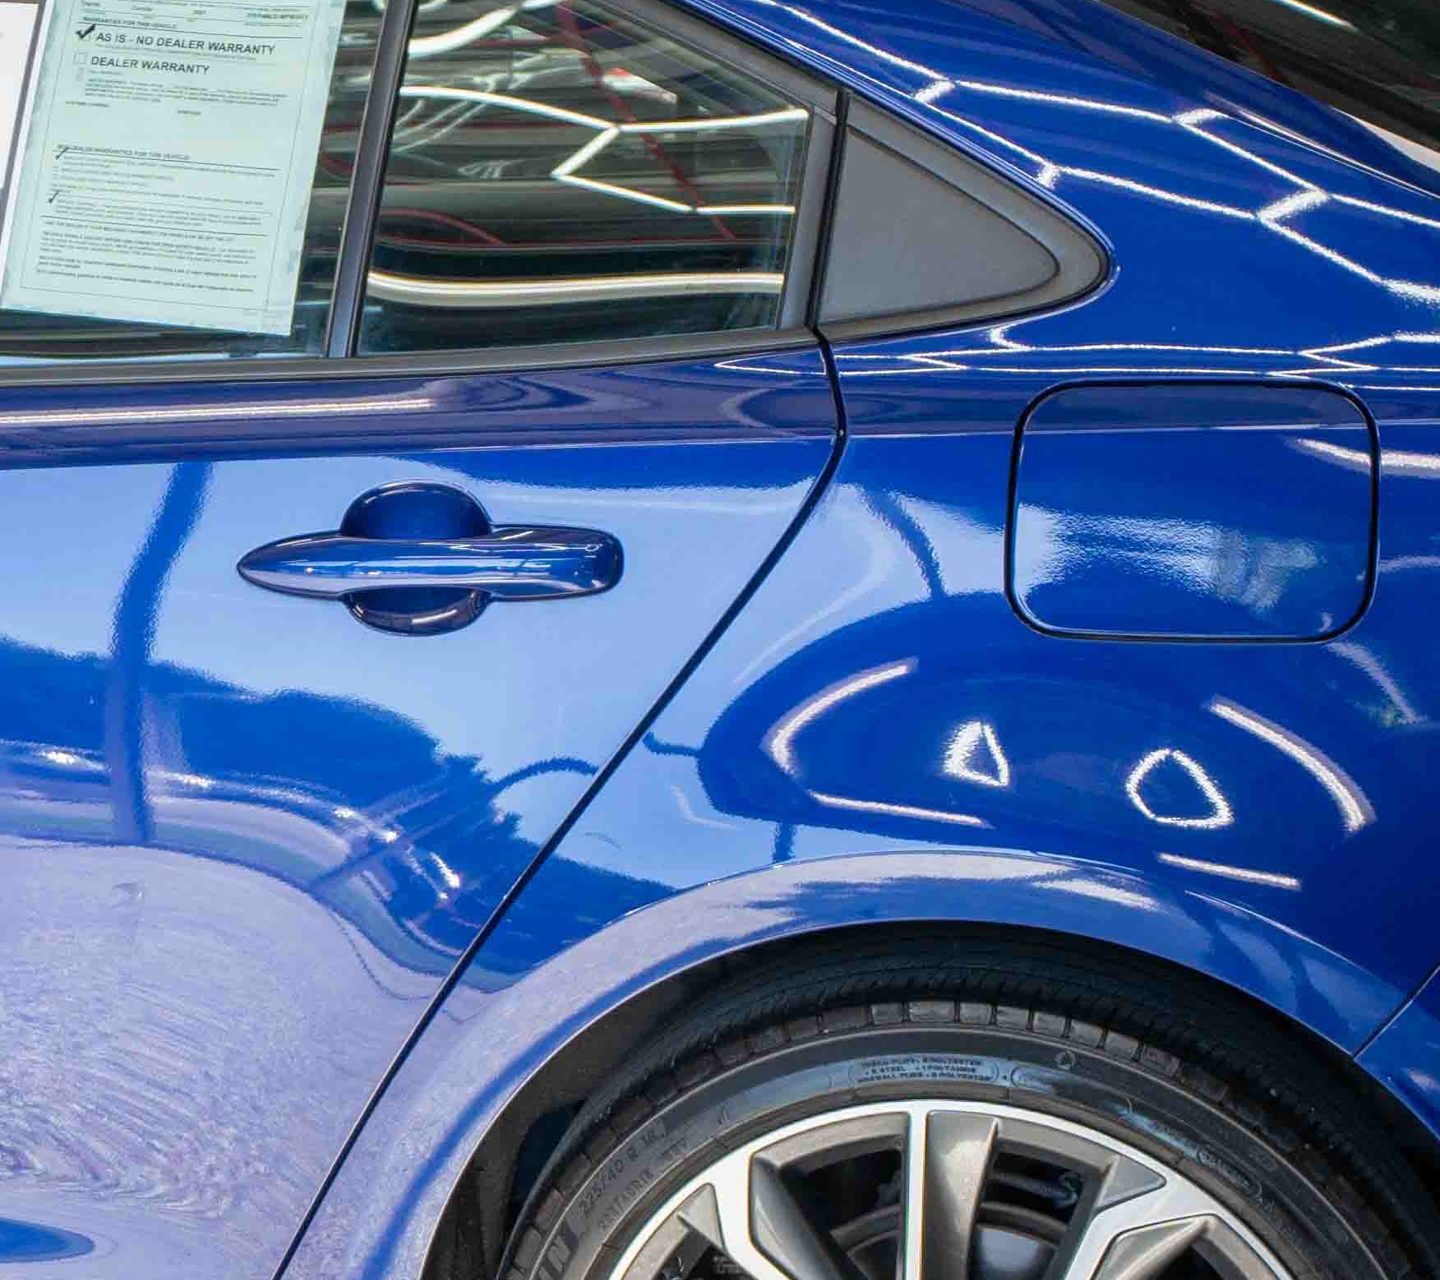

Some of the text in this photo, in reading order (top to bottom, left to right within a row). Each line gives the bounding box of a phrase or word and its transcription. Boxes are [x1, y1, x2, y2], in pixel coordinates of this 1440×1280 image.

[95, 32, 112, 42] AS
[114, 34, 126, 44] IS
[136, 36, 154, 46] NO
[156, 37, 205, 50] DEALER
[208, 42, 276, 55] WARRANTY
[91, 56, 210, 74] DEALER WARRANTY
